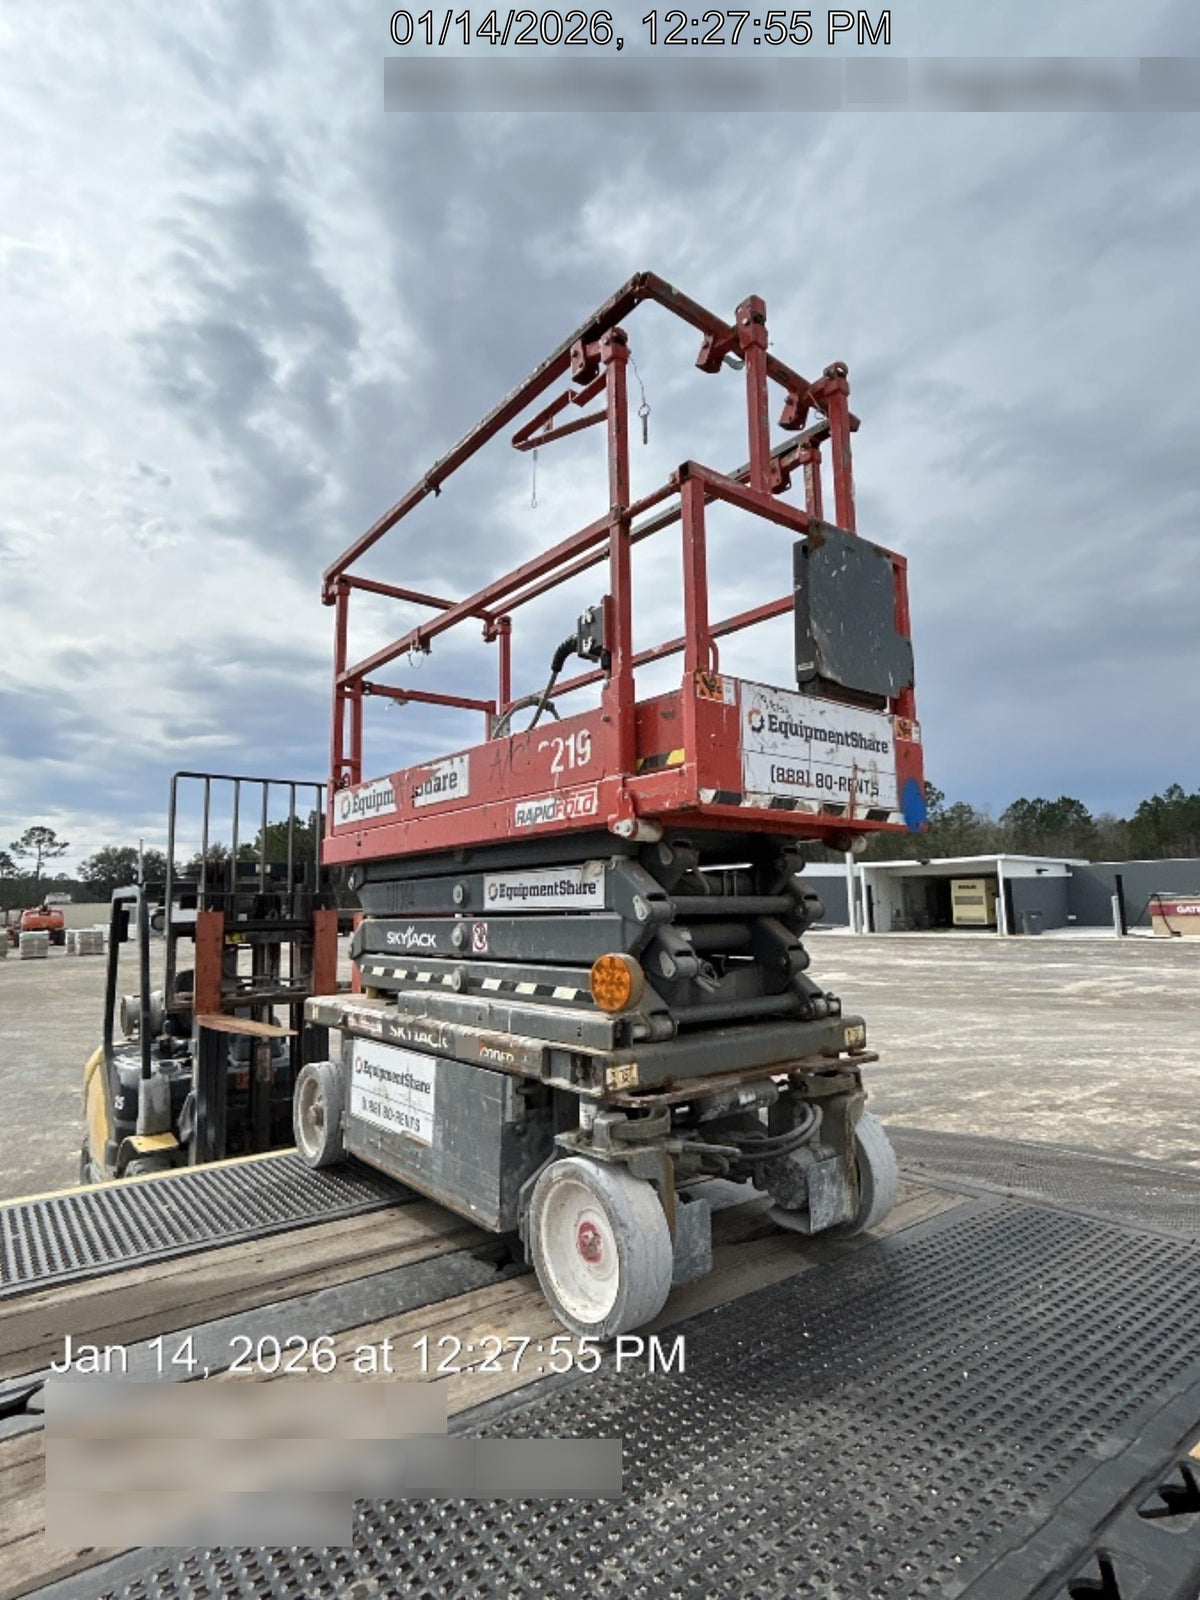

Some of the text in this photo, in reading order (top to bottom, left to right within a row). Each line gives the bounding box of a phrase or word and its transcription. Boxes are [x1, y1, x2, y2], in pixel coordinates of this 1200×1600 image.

[767, 713, 890, 755] EquipmentShare
[538, 729, 592, 774] 219
[499, 880, 597, 901] EquipmentShare
[386, 925, 438, 949] SKYJACK
